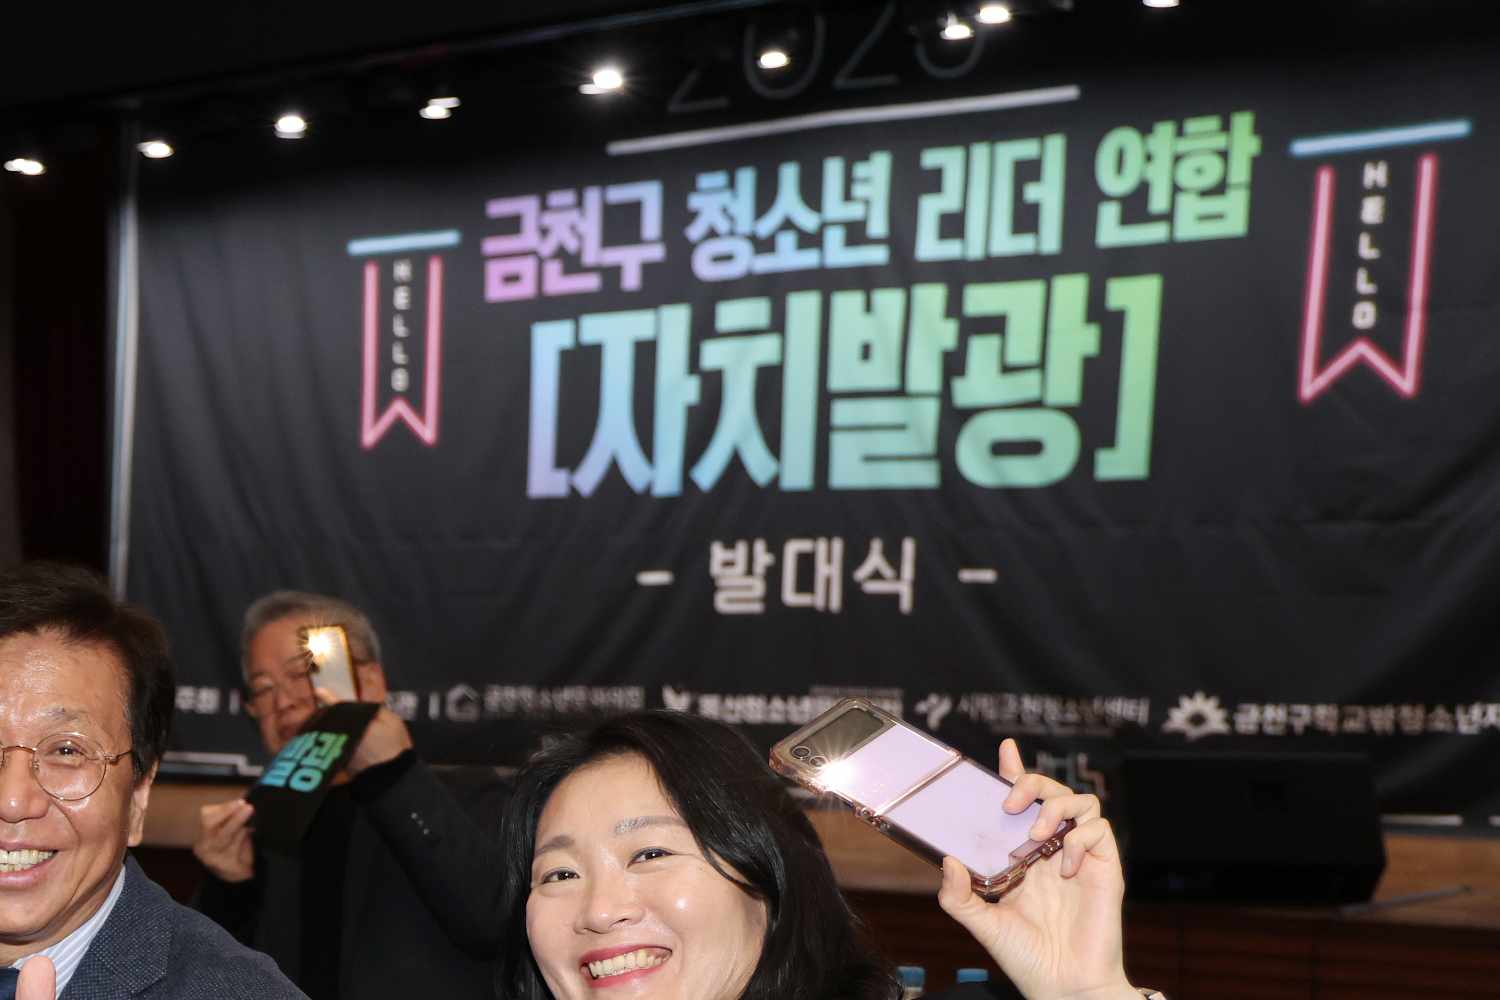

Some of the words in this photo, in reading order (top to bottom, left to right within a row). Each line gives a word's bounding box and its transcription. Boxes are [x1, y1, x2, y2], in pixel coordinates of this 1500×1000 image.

[481, 183, 665, 302] 금천구
[685, 151, 892, 282] 청소년
[914, 134, 1066, 262] 리더
[1095, 112, 1261, 248] 연합
[1351, 160, 1390, 330] HELLO
[709, 536, 917, 615] 발대식
